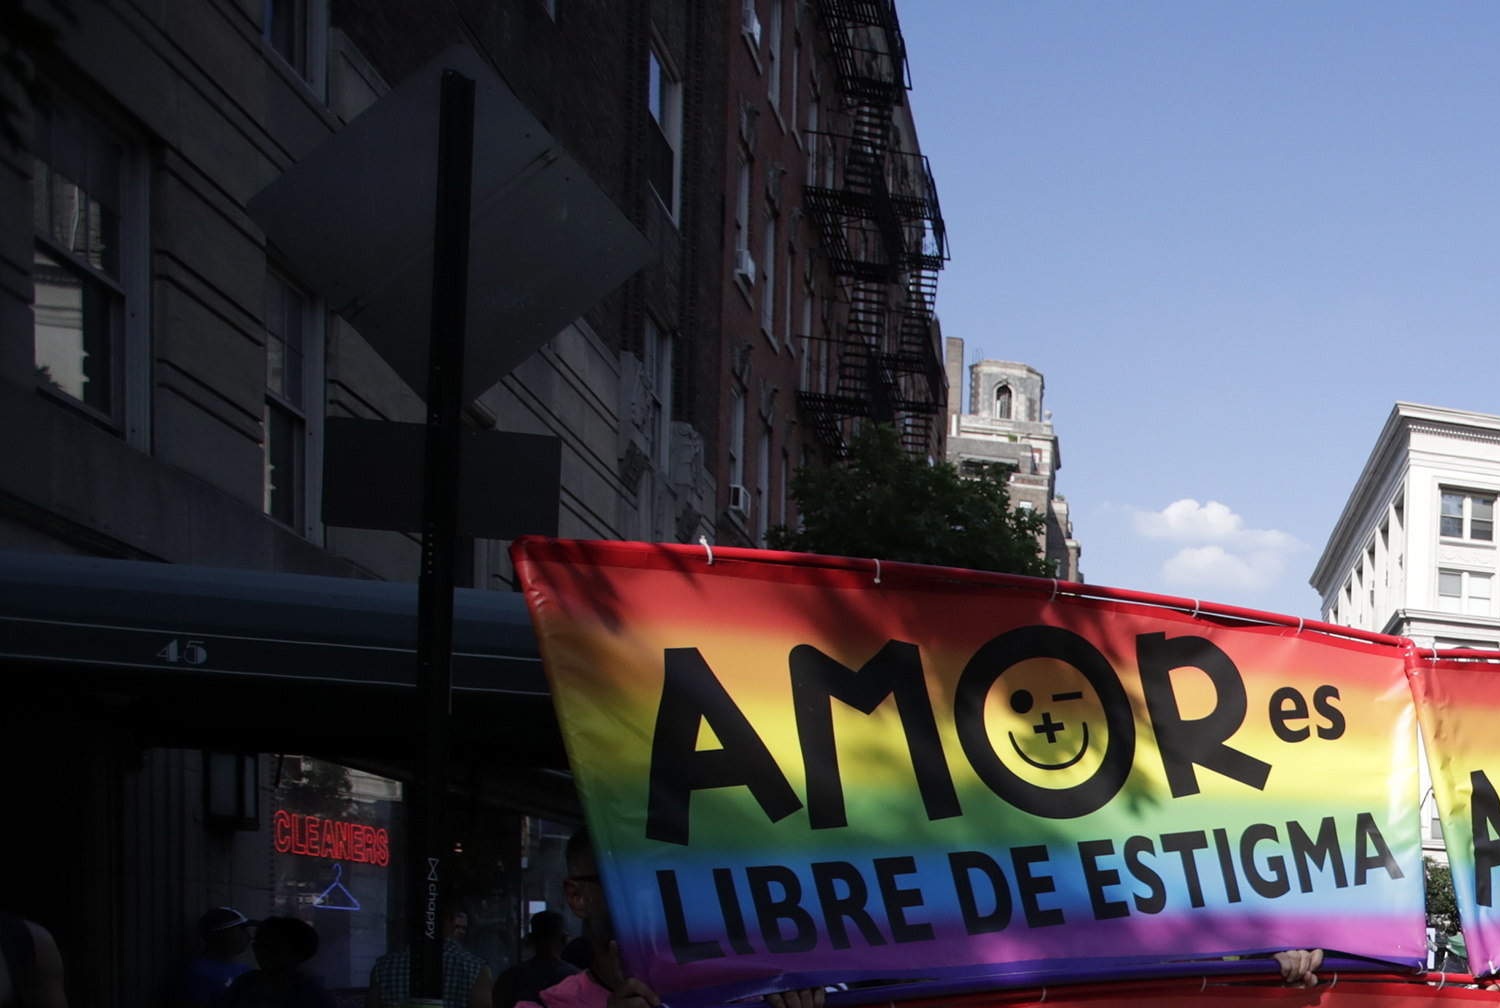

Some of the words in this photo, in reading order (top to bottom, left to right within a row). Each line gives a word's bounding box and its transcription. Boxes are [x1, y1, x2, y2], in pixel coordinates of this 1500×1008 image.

[156, 638, 208, 665] 45
[645, 624, 1273, 846] AMOR
[1269, 684, 1346, 743] es
[273, 809, 391, 867] CLEANERS
[424, 883, 440, 941] chappy
[655, 855, 936, 966] LIBRE
[947, 844, 1066, 936] DE
[1077, 811, 1405, 922] ESTIGMA
